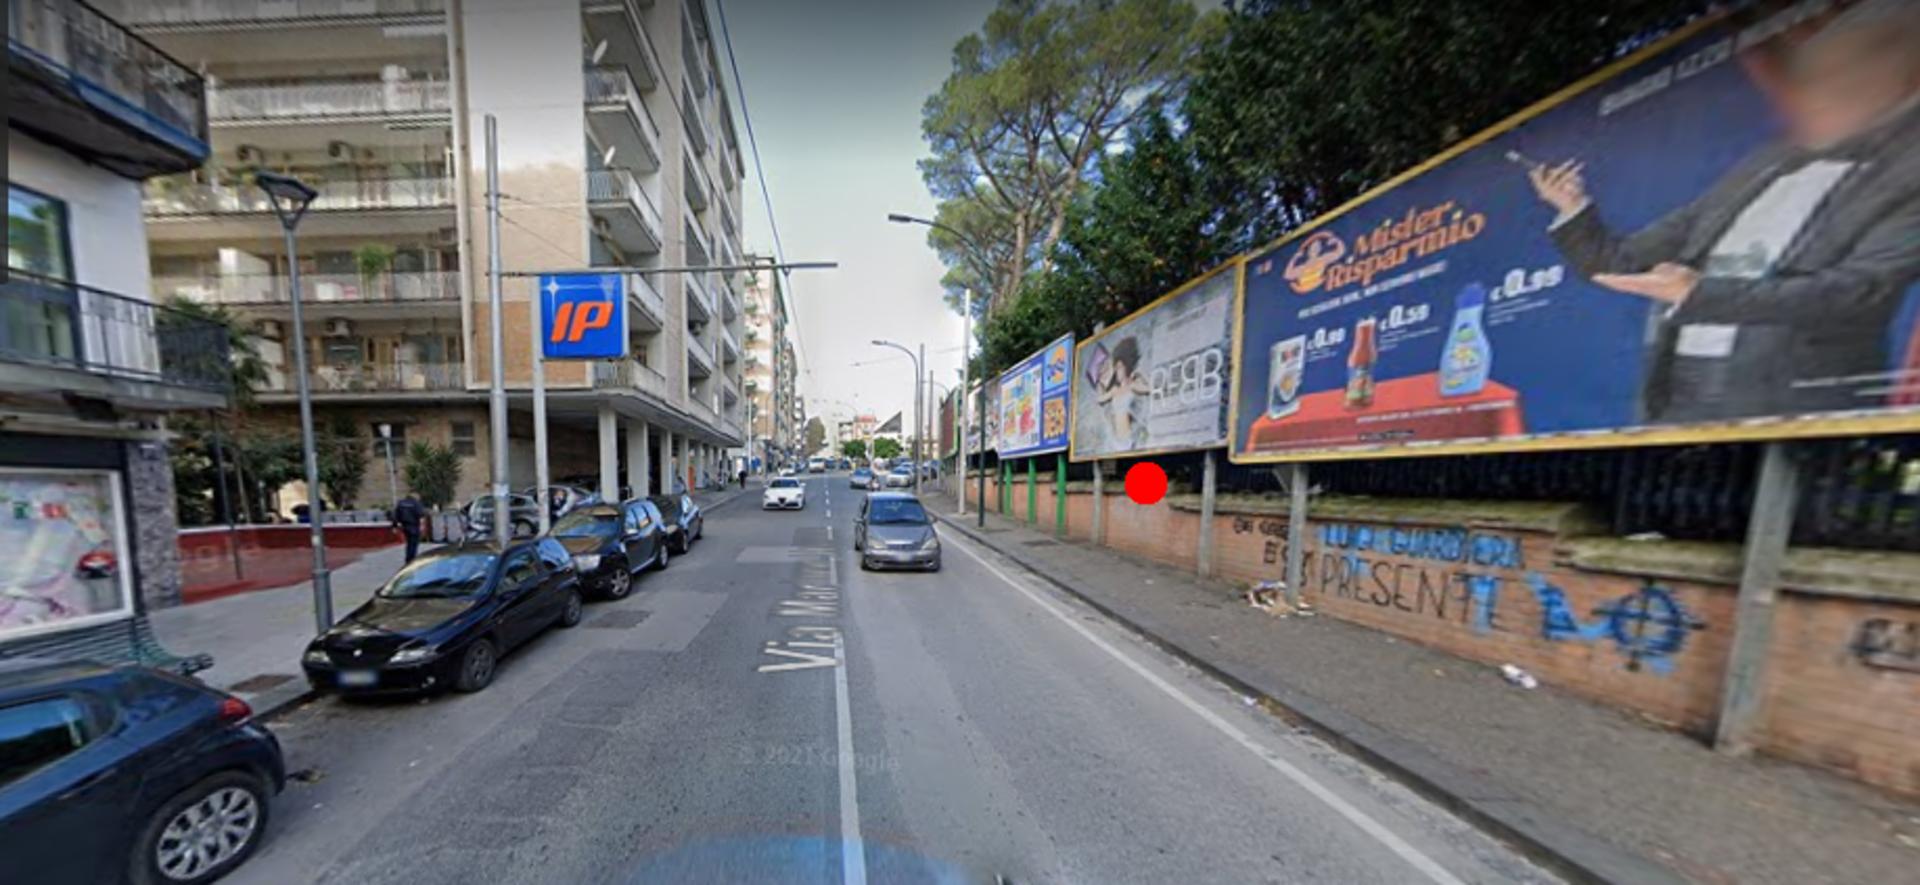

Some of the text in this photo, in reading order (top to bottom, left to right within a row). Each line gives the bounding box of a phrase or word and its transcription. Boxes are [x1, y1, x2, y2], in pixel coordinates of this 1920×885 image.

[1324, 211, 1486, 292] Risparmio
[1353, 202, 1454, 254] Mister
[550, 300, 614, 342] IP
